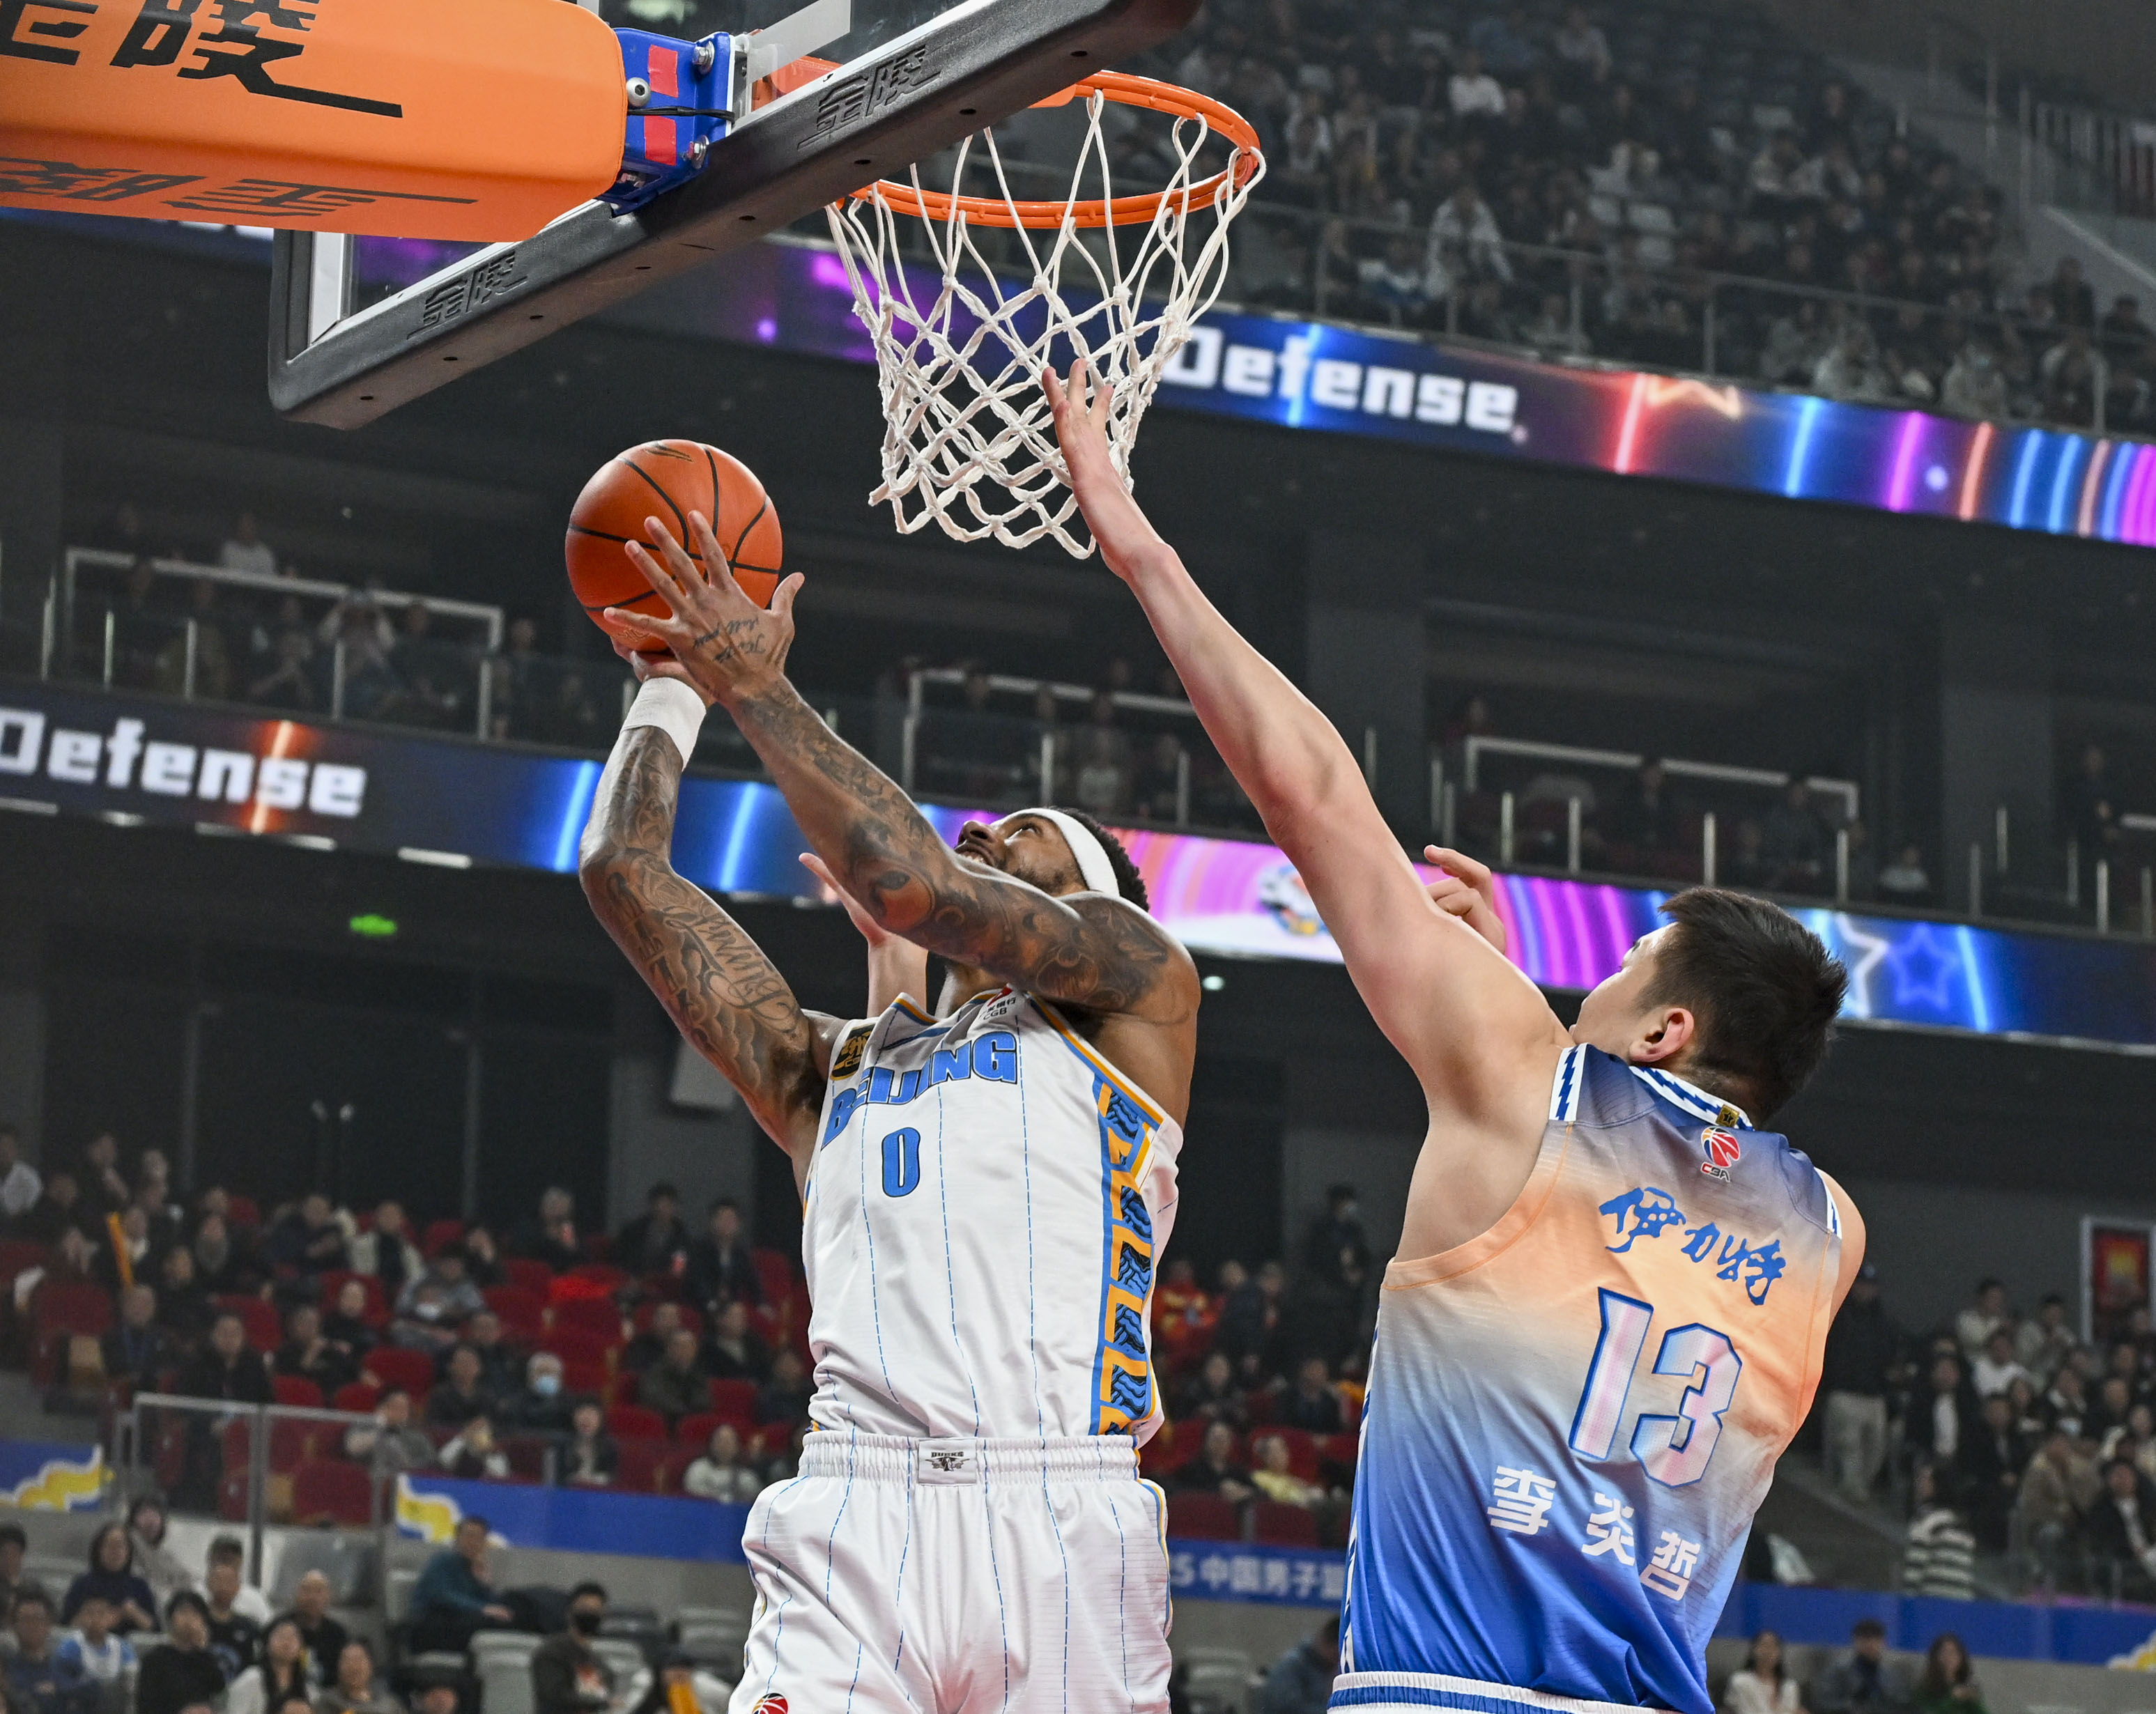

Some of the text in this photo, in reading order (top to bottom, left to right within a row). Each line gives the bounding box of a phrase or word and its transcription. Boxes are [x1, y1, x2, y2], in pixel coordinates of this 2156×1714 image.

[797, 44, 941, 150] 金陵
[407, 251, 528, 340] 金陵
[1157, 325, 1518, 433] Defense
[0, 707, 367, 818] Defense
[983, 1007, 1008, 1020] CGB
[820, 1030, 1017, 1152] BEIJING
[881, 1127, 921, 1198] 0
[1701, 1163, 1730, 1182] CBA
[1599, 1187, 1786, 1306] 伊力特
[1569, 1287, 1742, 1488] 13
[1487, 1465, 1701, 1601] 李炎哲
